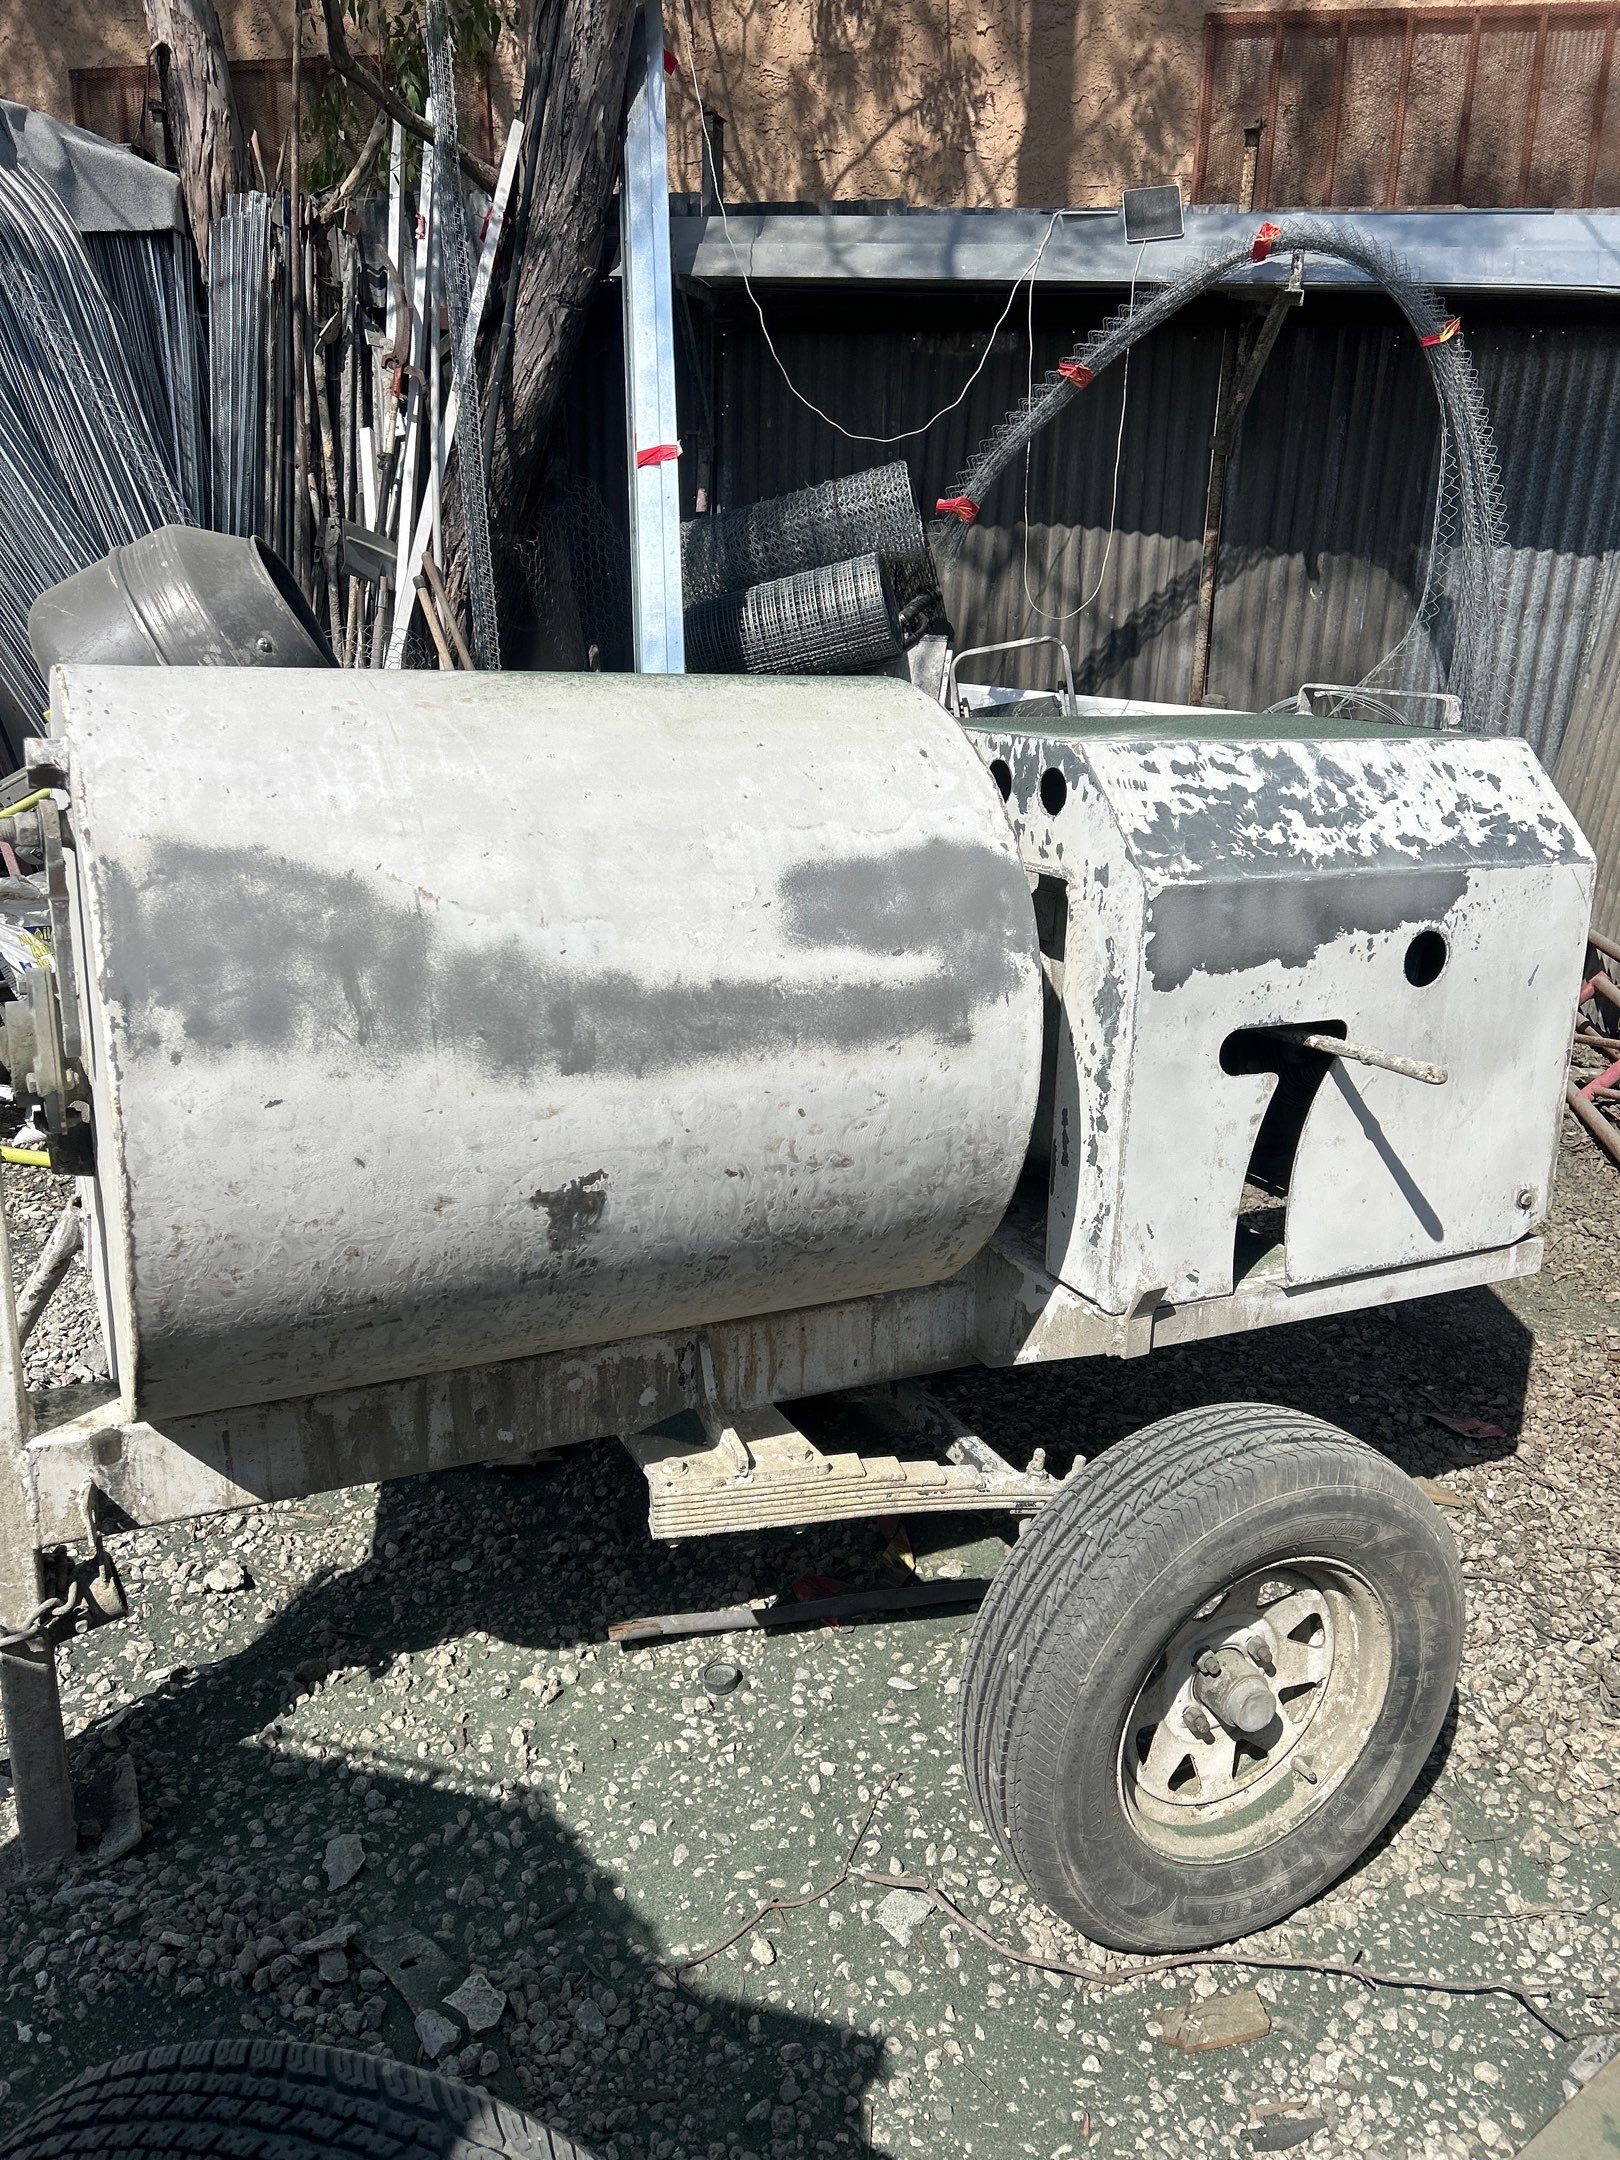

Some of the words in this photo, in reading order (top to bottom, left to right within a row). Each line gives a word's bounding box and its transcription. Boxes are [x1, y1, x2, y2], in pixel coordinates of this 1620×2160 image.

[1260, 1521, 1367, 1552] NANKANG
[1330, 1794, 1349, 1816] DOT
[1208, 1884, 1290, 1923] CX-668
